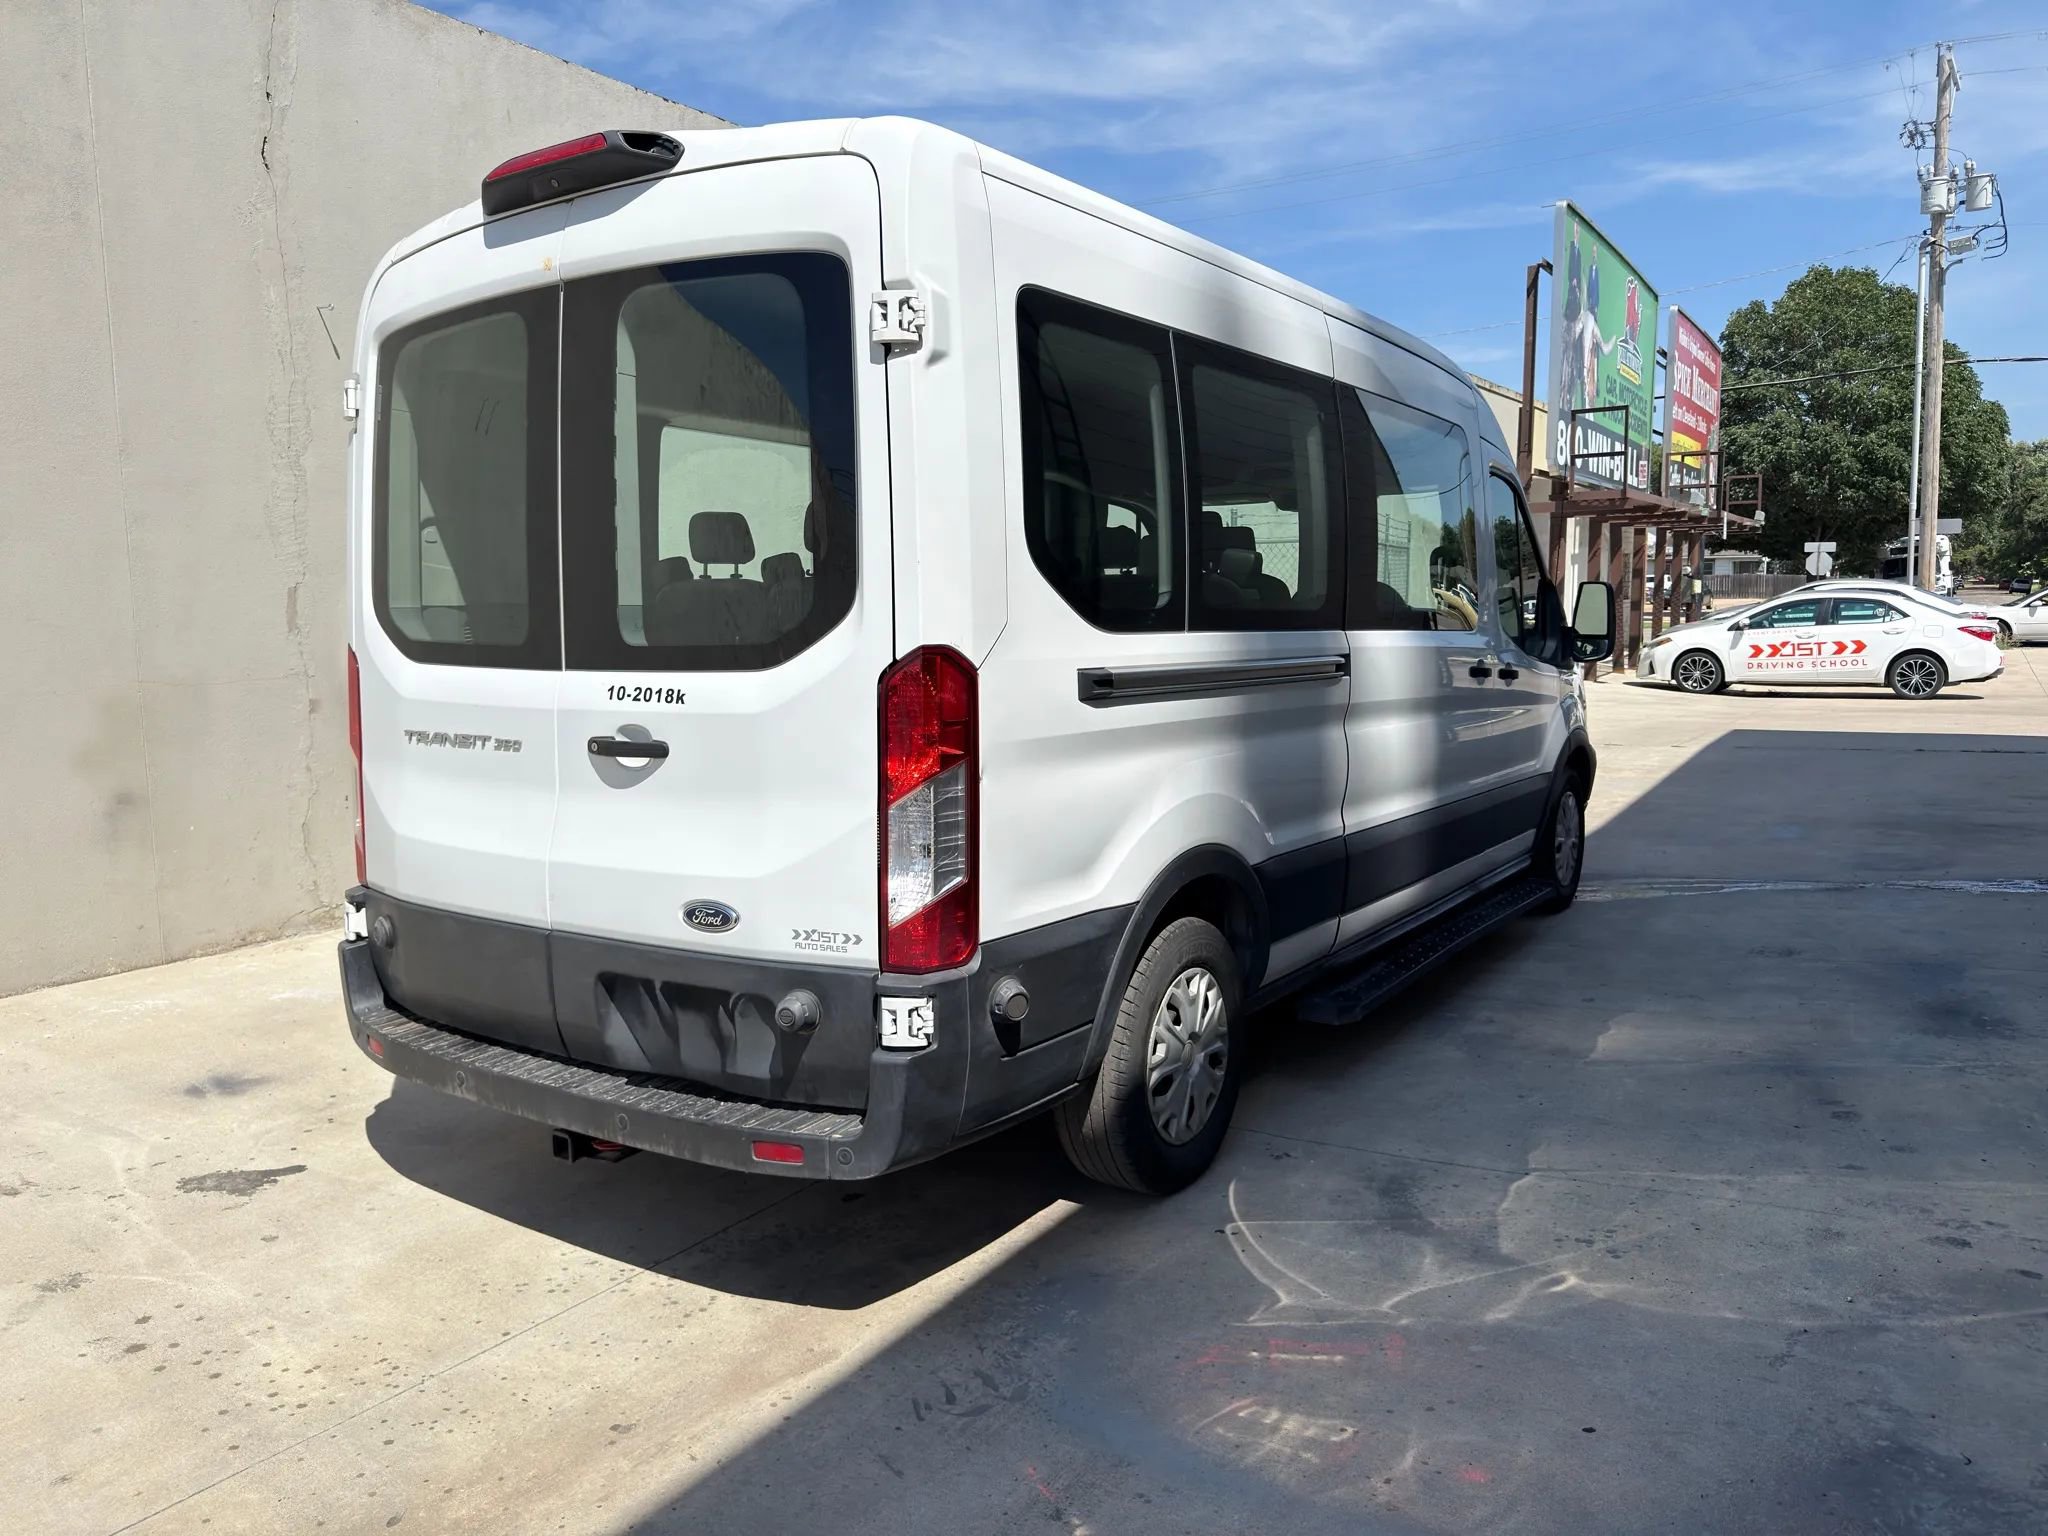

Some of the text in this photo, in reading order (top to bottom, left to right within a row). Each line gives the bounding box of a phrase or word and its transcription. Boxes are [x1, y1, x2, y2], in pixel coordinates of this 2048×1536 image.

[1747, 658, 1868, 670] DRIVING SCHOOL
[607, 685, 686, 705] 10-2018k
[404, 730, 522, 752] TRANSIT 350
[692, 908, 723, 926] Ford
[794, 941, 848, 953] AUTO SALES
